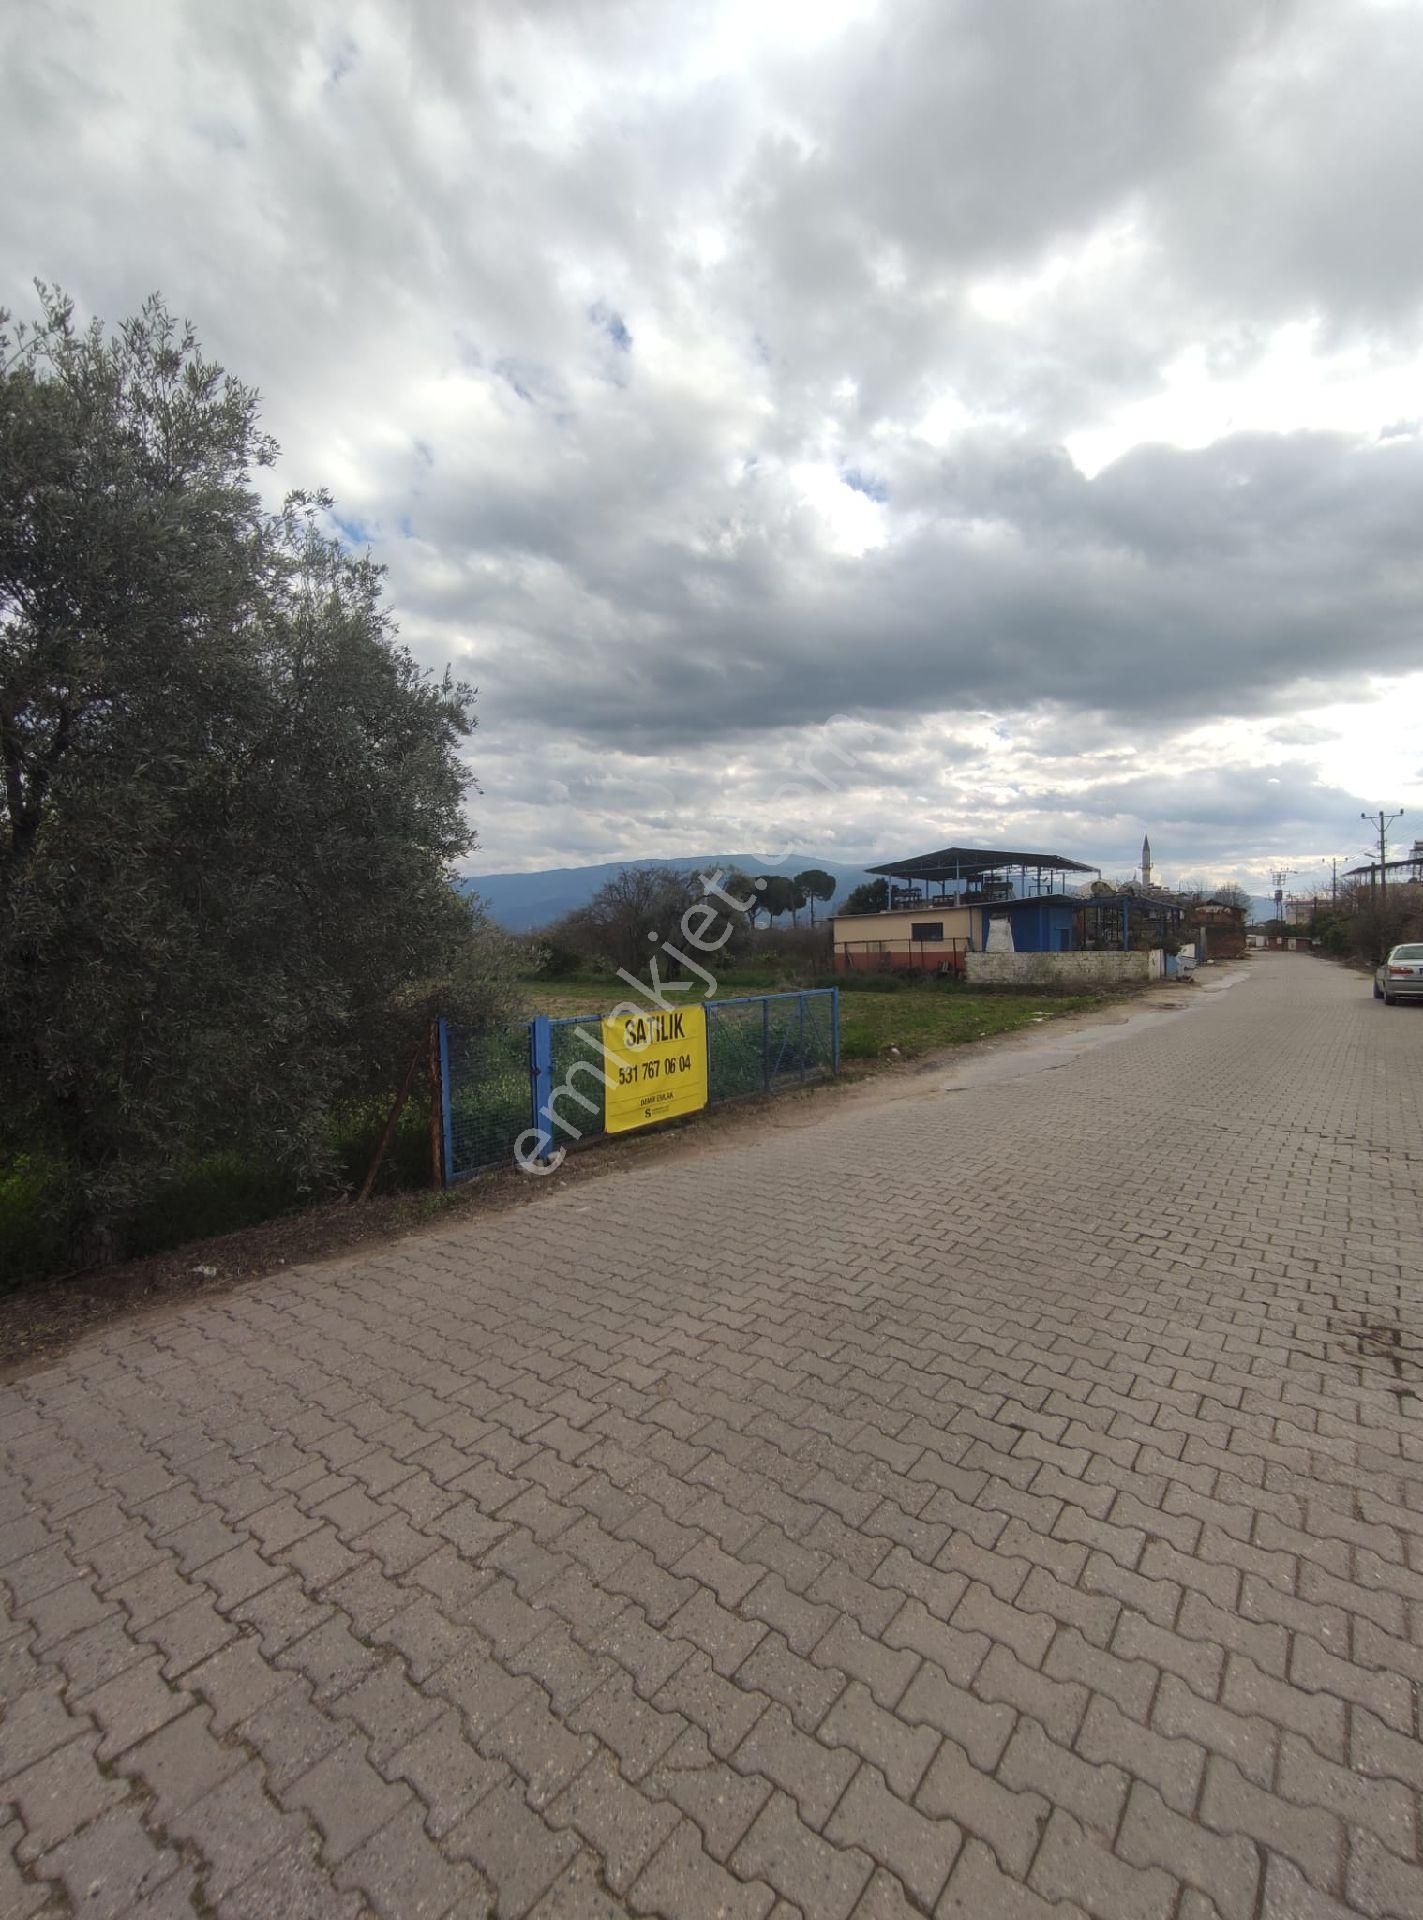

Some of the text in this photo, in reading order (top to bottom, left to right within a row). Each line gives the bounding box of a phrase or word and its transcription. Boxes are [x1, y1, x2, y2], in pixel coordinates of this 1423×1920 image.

[624, 1012, 686, 1047] SATILIK
[618, 1054, 692, 1085] 531 767 06 04
